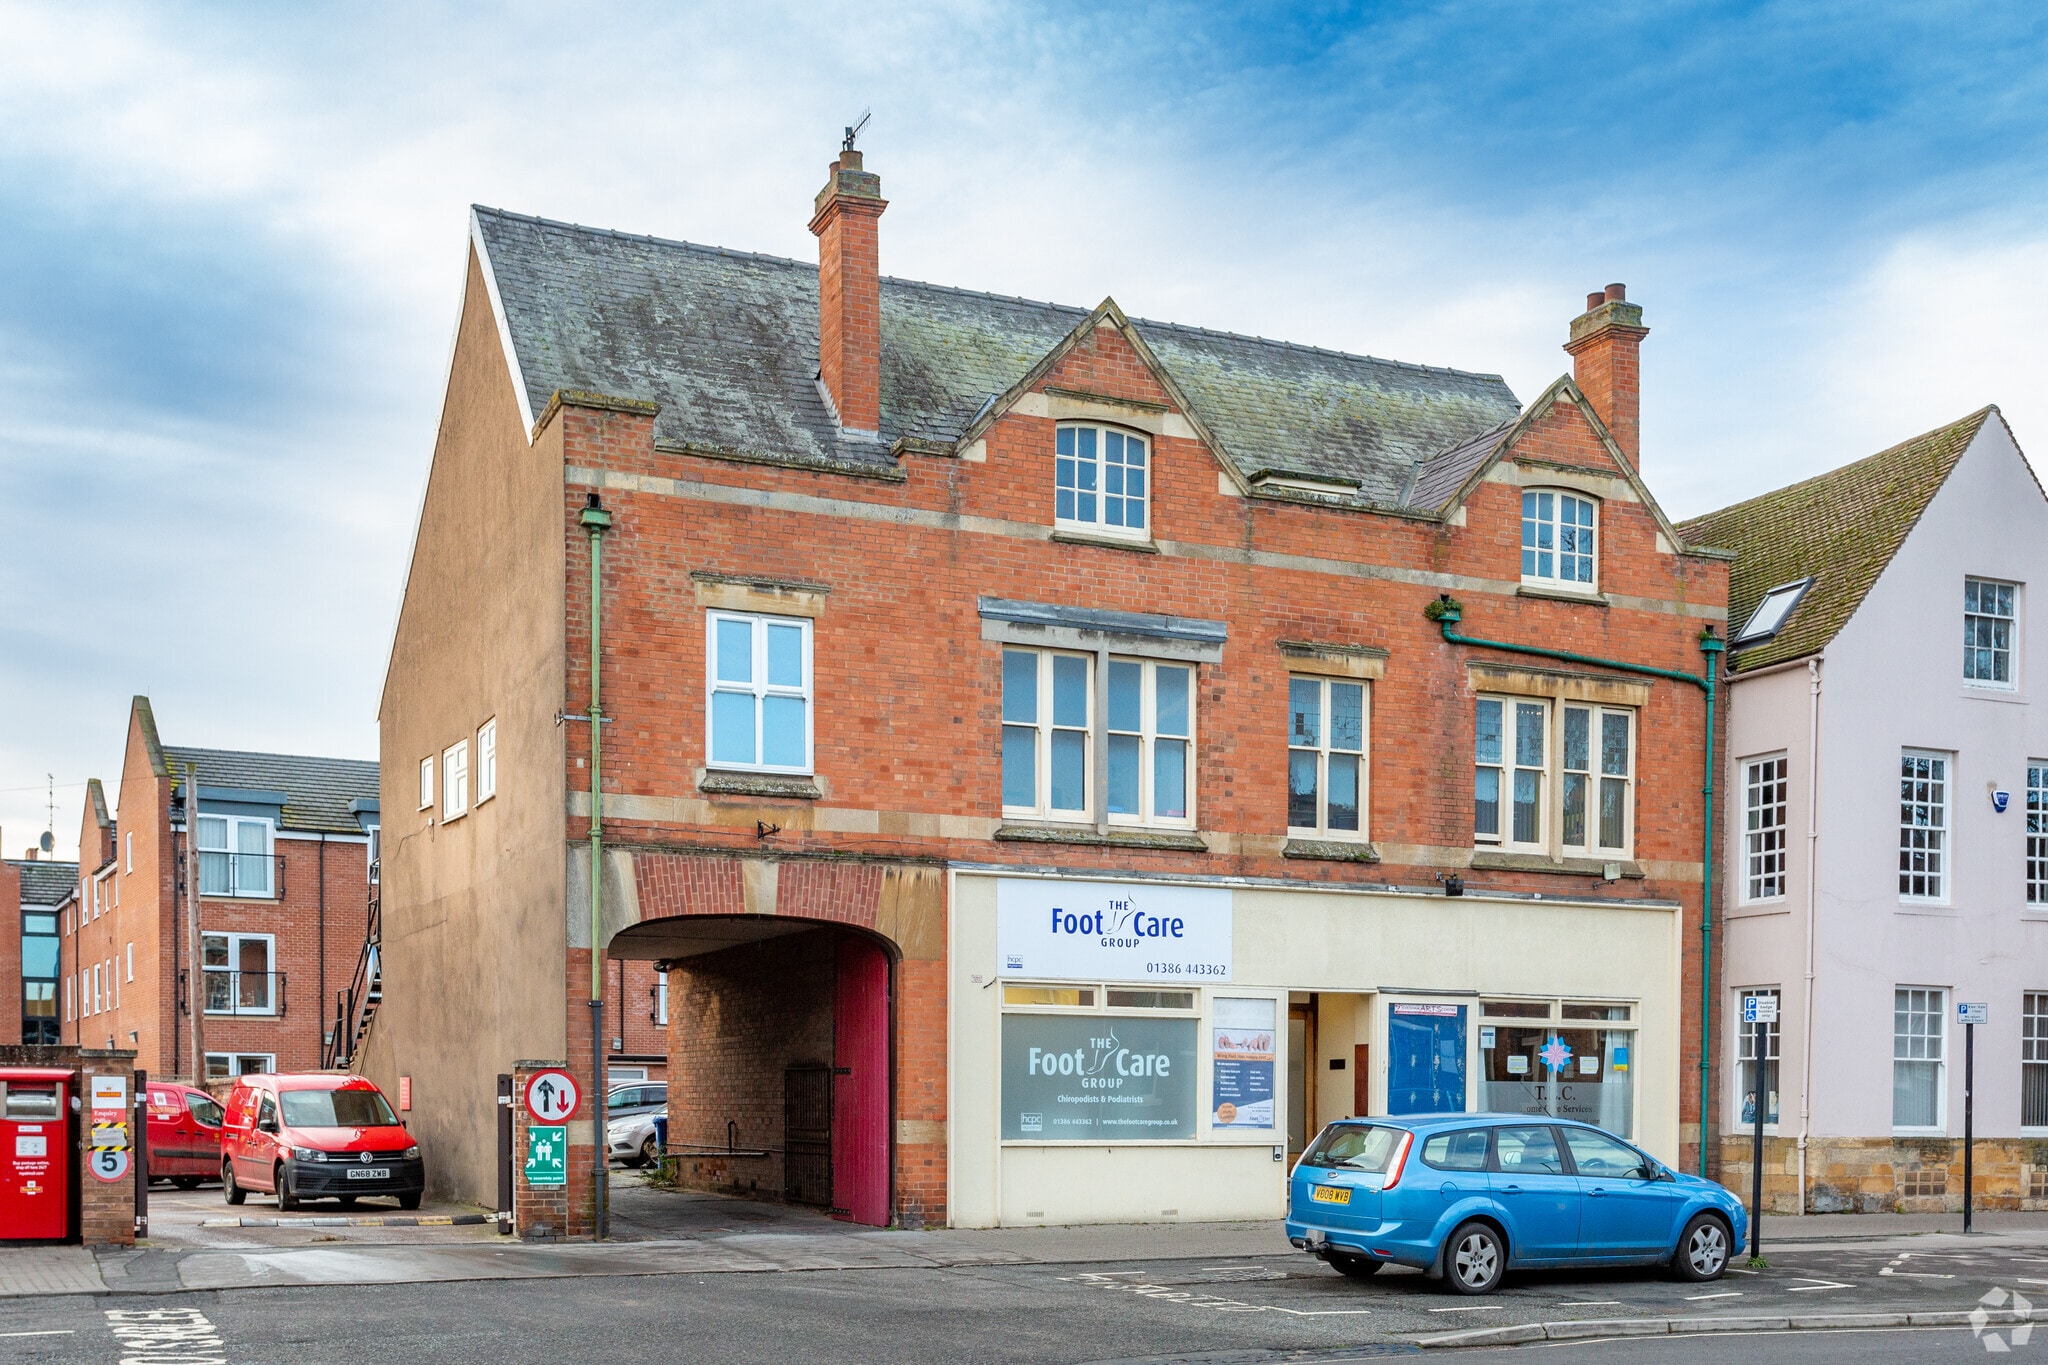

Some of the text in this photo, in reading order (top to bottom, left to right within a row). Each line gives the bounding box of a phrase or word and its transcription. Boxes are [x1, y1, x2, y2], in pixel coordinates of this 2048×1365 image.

[1109, 900, 1129, 911] THE
[1052, 908, 1184, 938] Foot Care
[1101, 937, 1140, 949] GROUP
[1146, 962, 1226, 976] 01386 443362
[1090, 1038, 1112, 1049] THE
[1029, 1047, 1171, 1077] Foot Care
[1081, 1077, 1124, 1089] GROUP
[1057, 1094, 1144, 1104] Chiropodists & Podiatrists
[94, 1110, 117, 1118] Enquiry
[1563, 1104, 1592, 1113] Services
[1022, 1114, 1041, 1125] hcpc
[1102, 1117, 1178, 1127] www.thefootcaregroup.co.uk
[101, 1151, 118, 1172] 5
[350, 1170, 371, 1178] GN68
